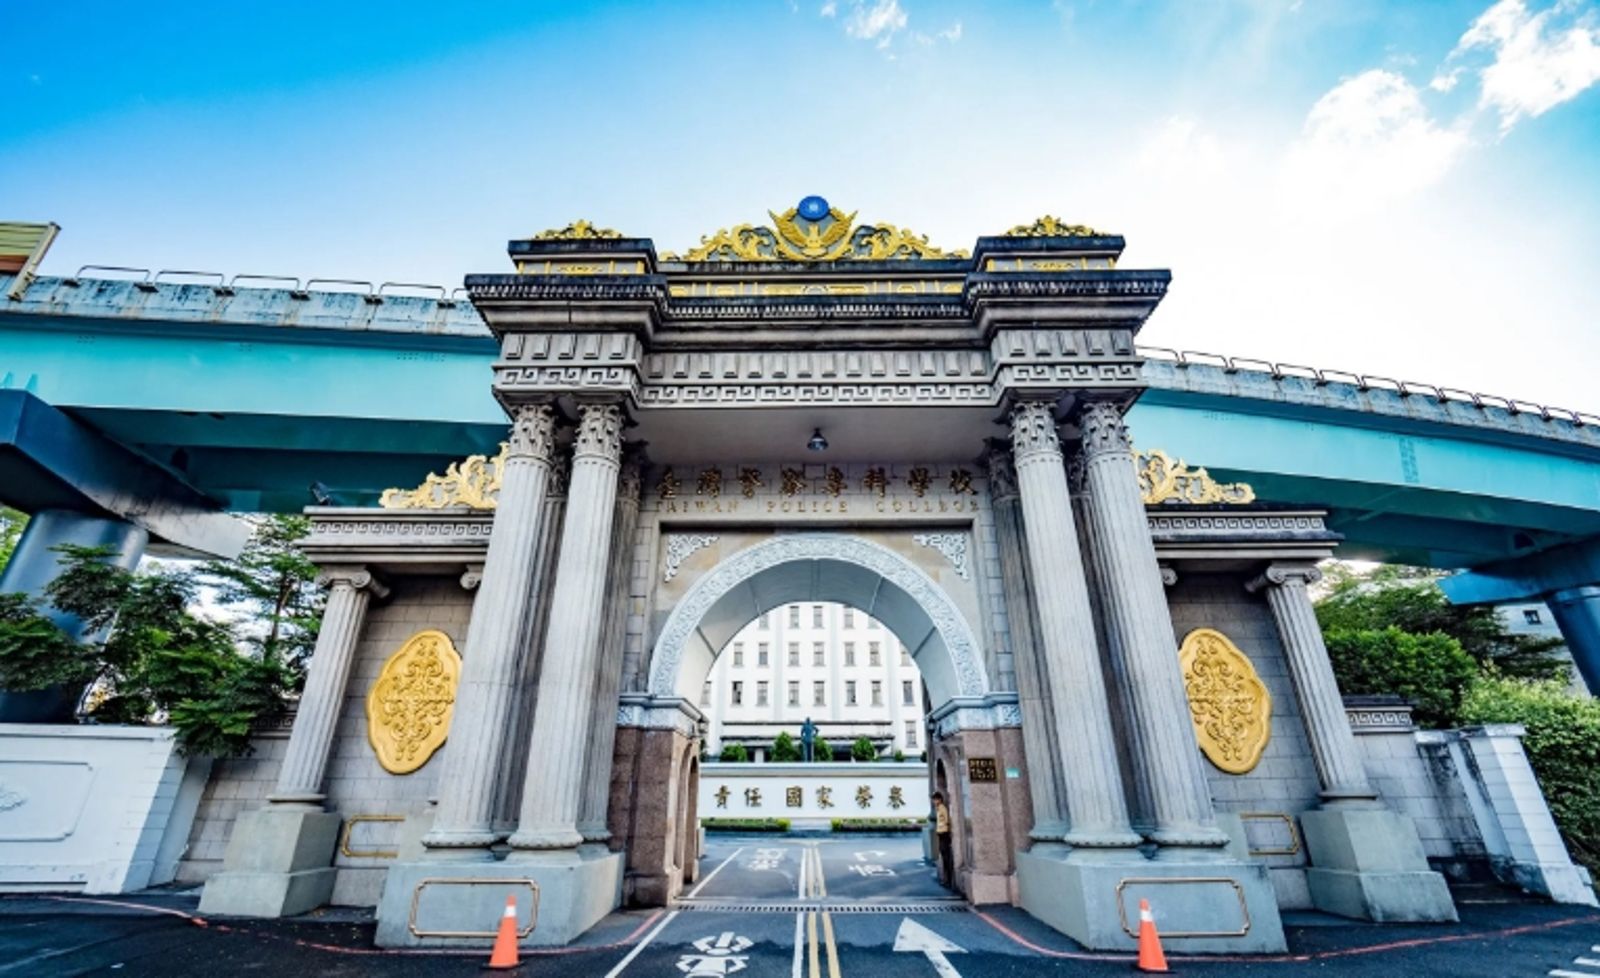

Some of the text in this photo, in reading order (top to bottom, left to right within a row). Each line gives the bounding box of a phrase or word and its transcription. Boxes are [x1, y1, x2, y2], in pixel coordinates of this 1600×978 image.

[656, 501, 980, 512] TAIWAN POLICE COLLEGE
[714, 785, 762, 809] 責任
[786, 785, 835, 809] 國家
